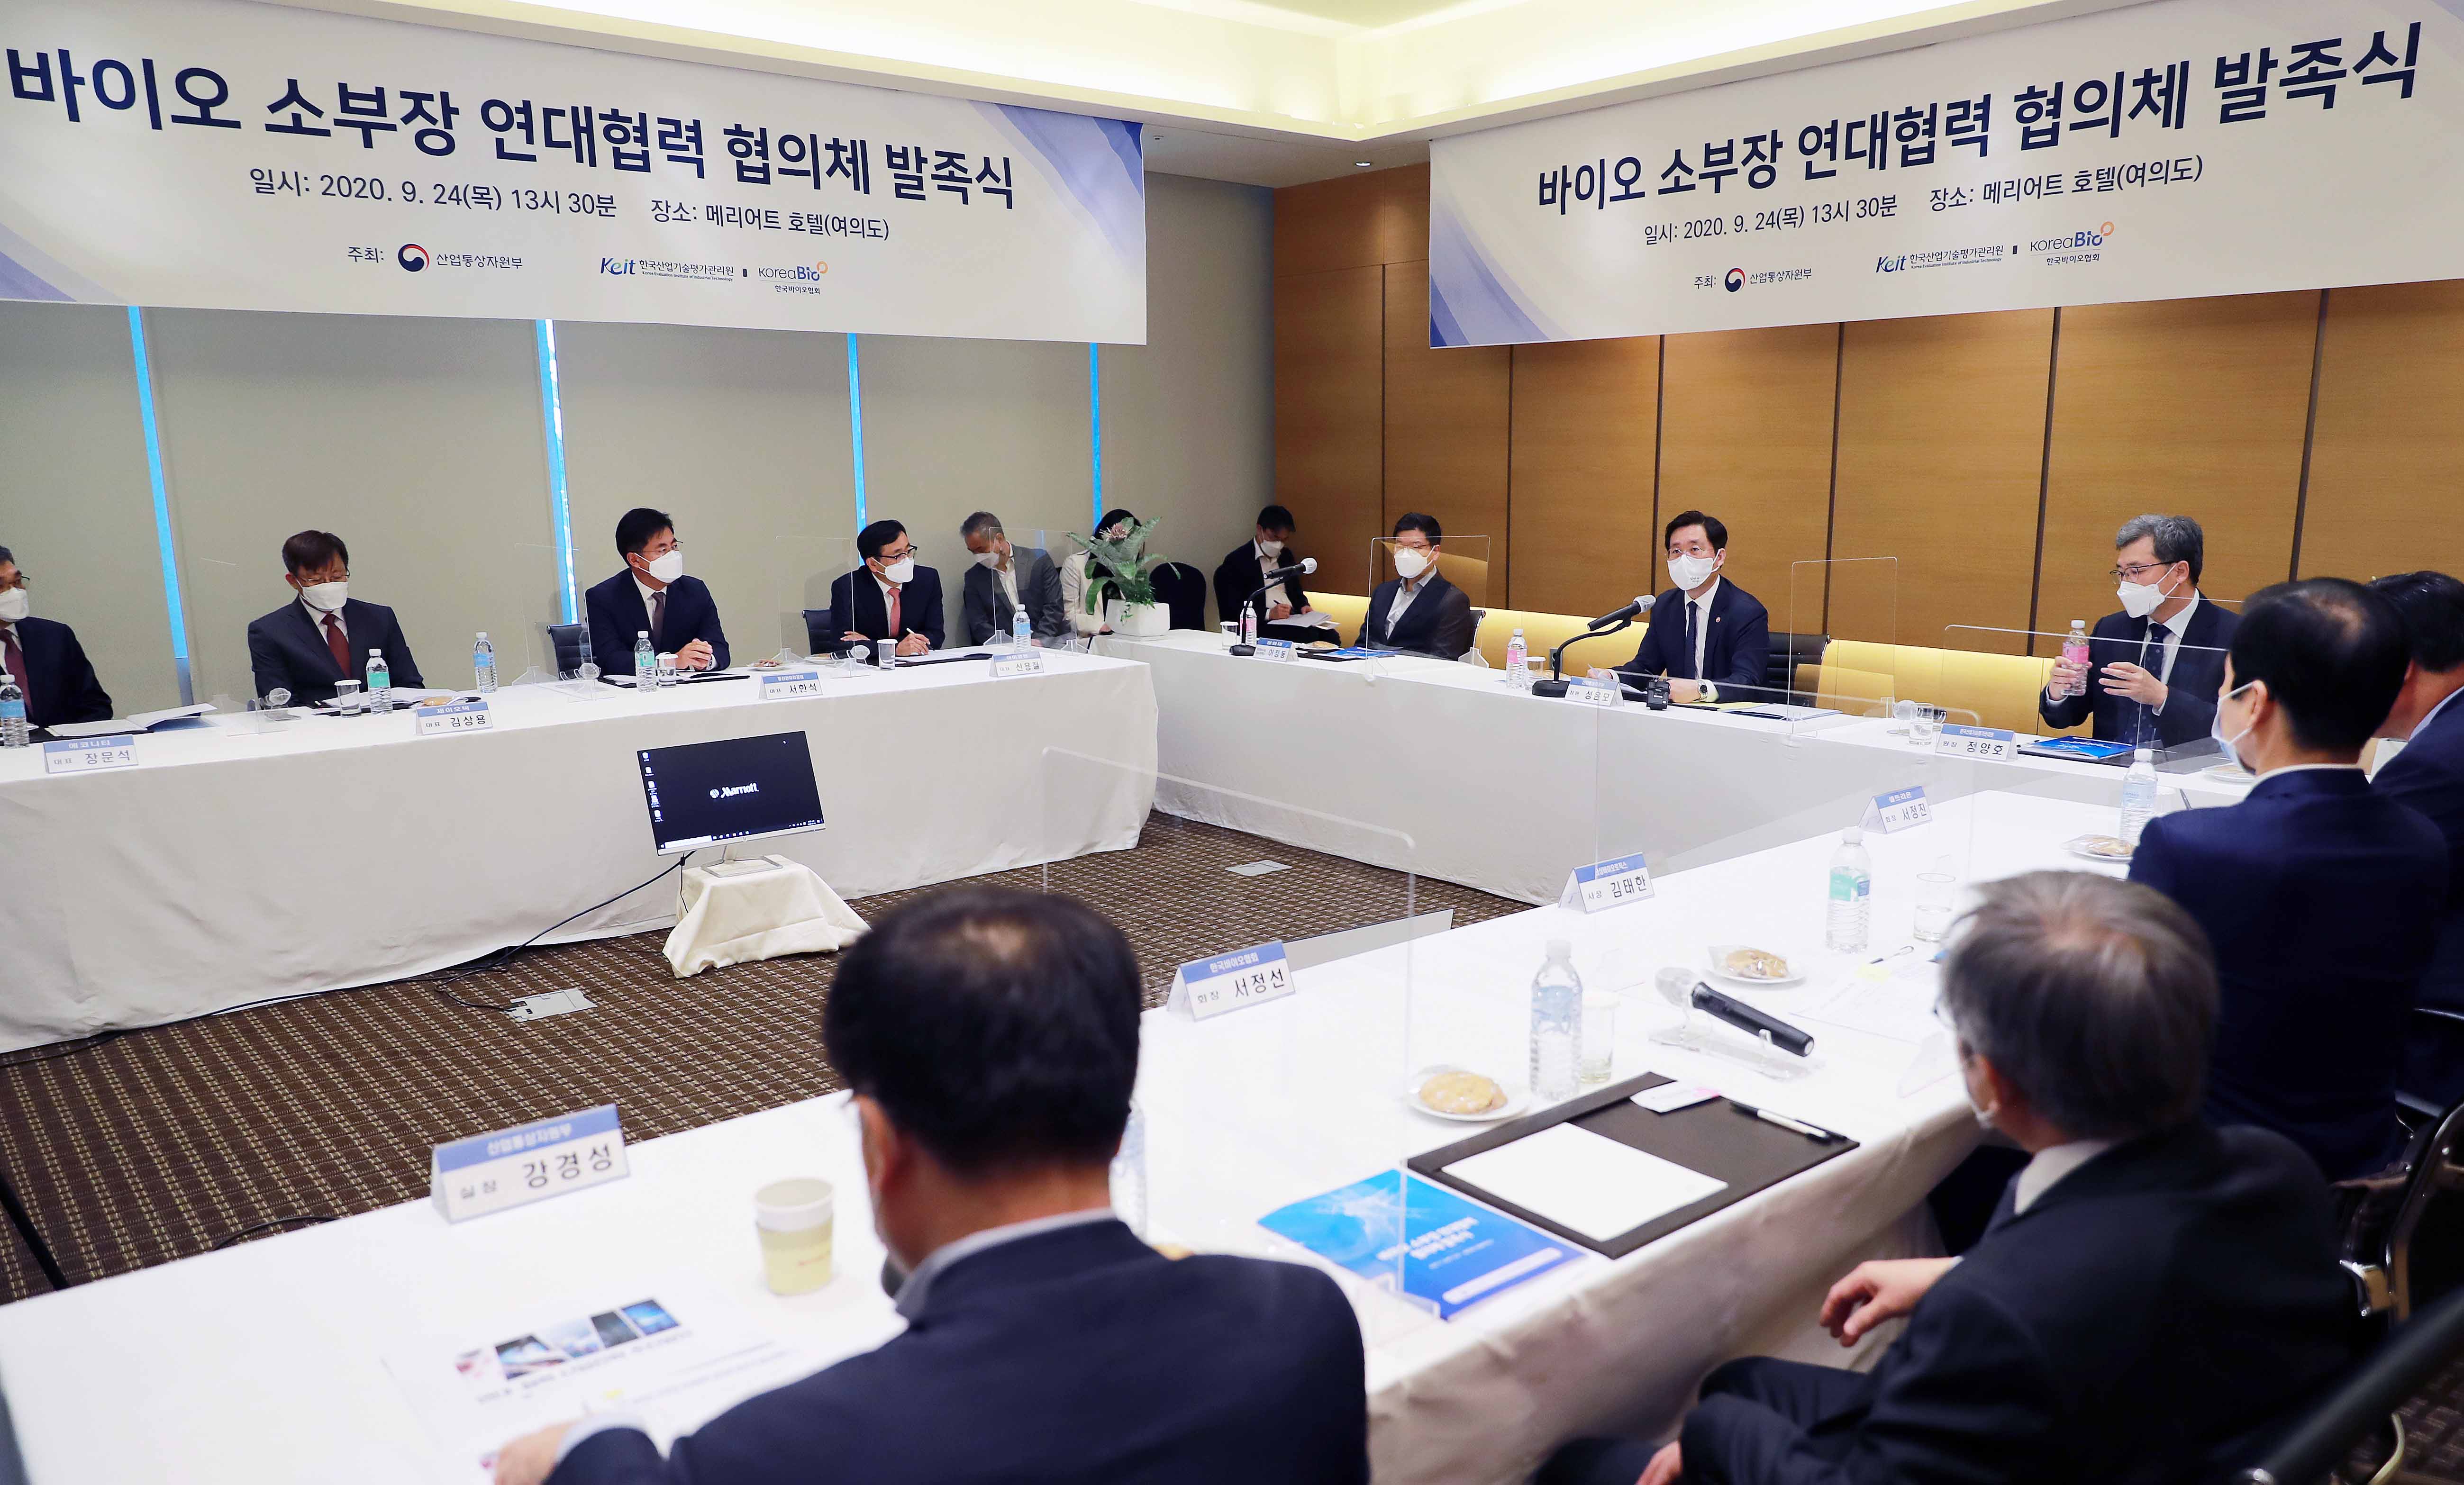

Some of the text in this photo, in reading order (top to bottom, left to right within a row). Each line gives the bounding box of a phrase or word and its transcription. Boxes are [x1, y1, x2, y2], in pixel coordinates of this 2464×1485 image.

[1539, 22, 2421, 215] 바이오 소부장 연대협력 협의체 발족식
[7, 49, 1012, 209] 바이오 소부장 연대협력 협의체 발족식
[250, 169, 889, 241] 일시: 2020. 9. 24(목) 13시 30분 장소: 메리어트 호텔(여의도)
[1645, 155, 2202, 245] 일시: 2020. 9. 24(목) 13시 30분 장소: 메리어트 호텔(여의도)
[348, 247, 522, 269] 주최: 산업통상자원부
[1910, 245, 2003, 264] 한국산업기술평가관리원
[2047, 254, 2100, 265] 한국바이오협회
[600, 258, 636, 275] Keit
[639, 260, 734, 276] 한국산업기술평가관리원
[1876, 256, 1906, 273] Keit
[1694, 269, 1811, 289] 주최: 산업통상자원부
[775, 285, 820, 294] 한국바이오협회
[790, 683, 817, 693] 서한석
[1585, 690, 1609, 701] 성윤모
[450, 715, 485, 727] 김상용
[85, 750, 130, 764] 장문석
[1967, 741, 2003, 755] 정양호
[1902, 803, 1927, 820] 서정진
[1588, 875, 1646, 899] 사장 김태한
[1209, 952, 1259, 973] 한국바이오협회
[1198, 968, 1284, 1003] 회장 서정선
[522, 1143, 611, 1187] 강경성
